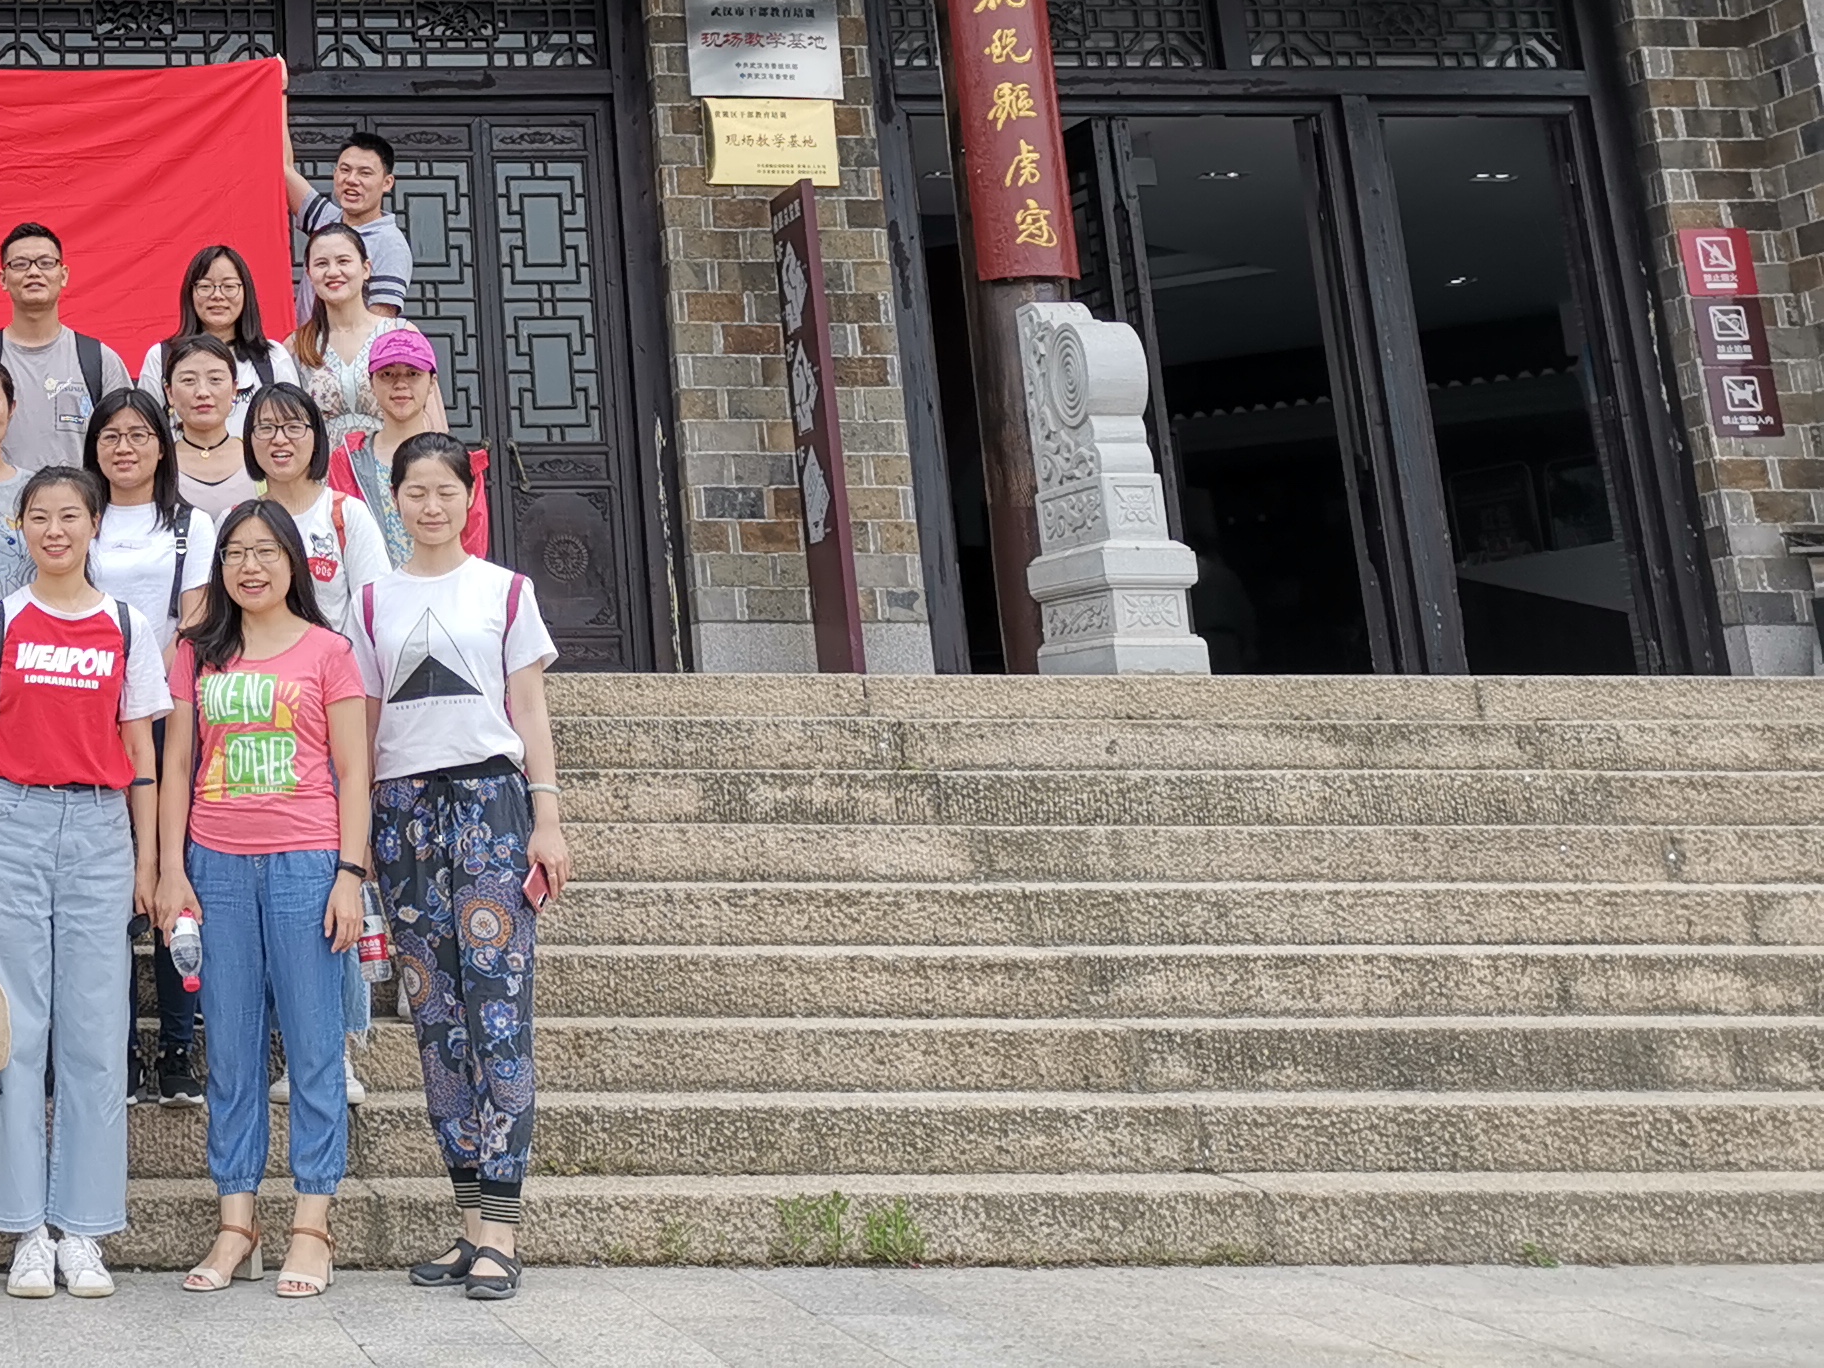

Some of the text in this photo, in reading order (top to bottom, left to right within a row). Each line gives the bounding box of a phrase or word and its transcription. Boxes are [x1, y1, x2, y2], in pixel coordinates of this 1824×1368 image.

[710, 6, 815, 18] 武汉市干部教育培训
[700, 32, 828, 50] 现场教学基地
[725, 133, 817, 148] 现场教学基地
[15, 642, 115, 677] WEAPON
[204, 672, 274, 724] LIKE NO
[229, 736, 301, 786] OTHER
